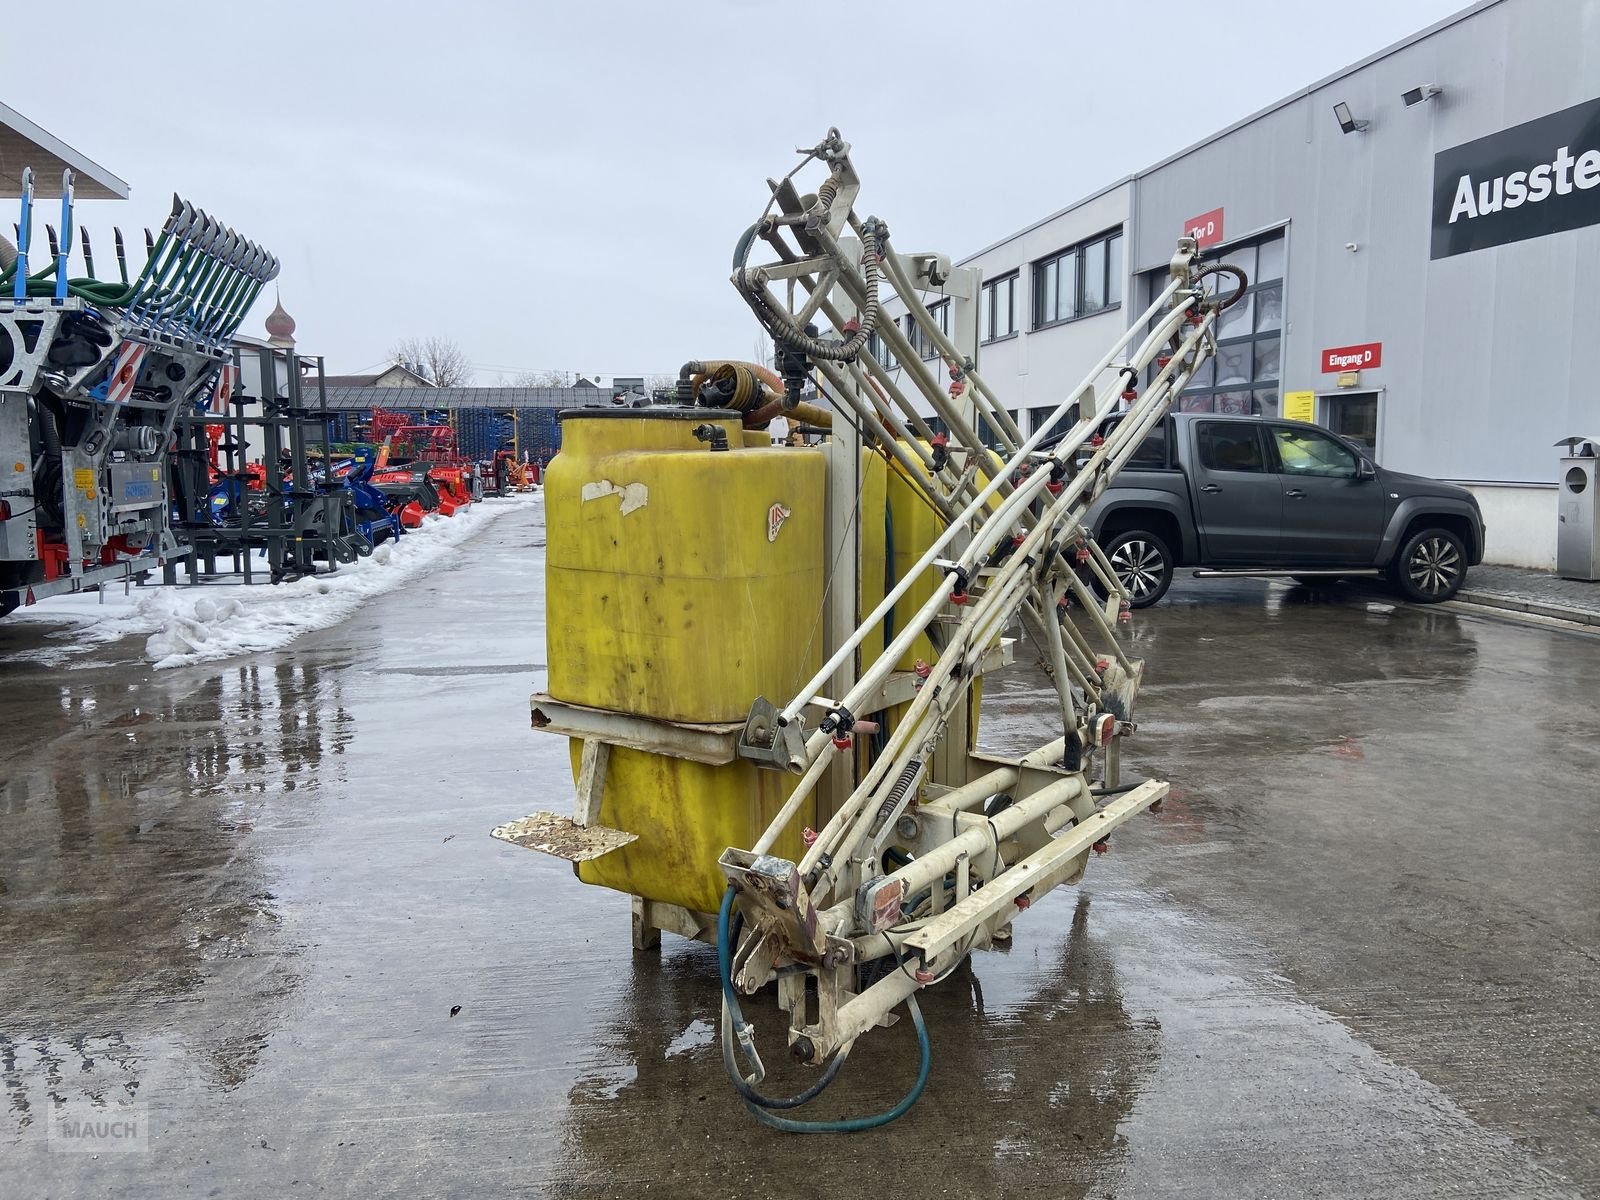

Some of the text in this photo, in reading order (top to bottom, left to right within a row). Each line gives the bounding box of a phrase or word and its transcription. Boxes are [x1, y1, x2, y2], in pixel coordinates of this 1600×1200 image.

[1448, 146, 1600, 224] Ausste
[1192, 221, 1215, 239] Tor D
[1329, 350, 1372, 367] Eingang D
